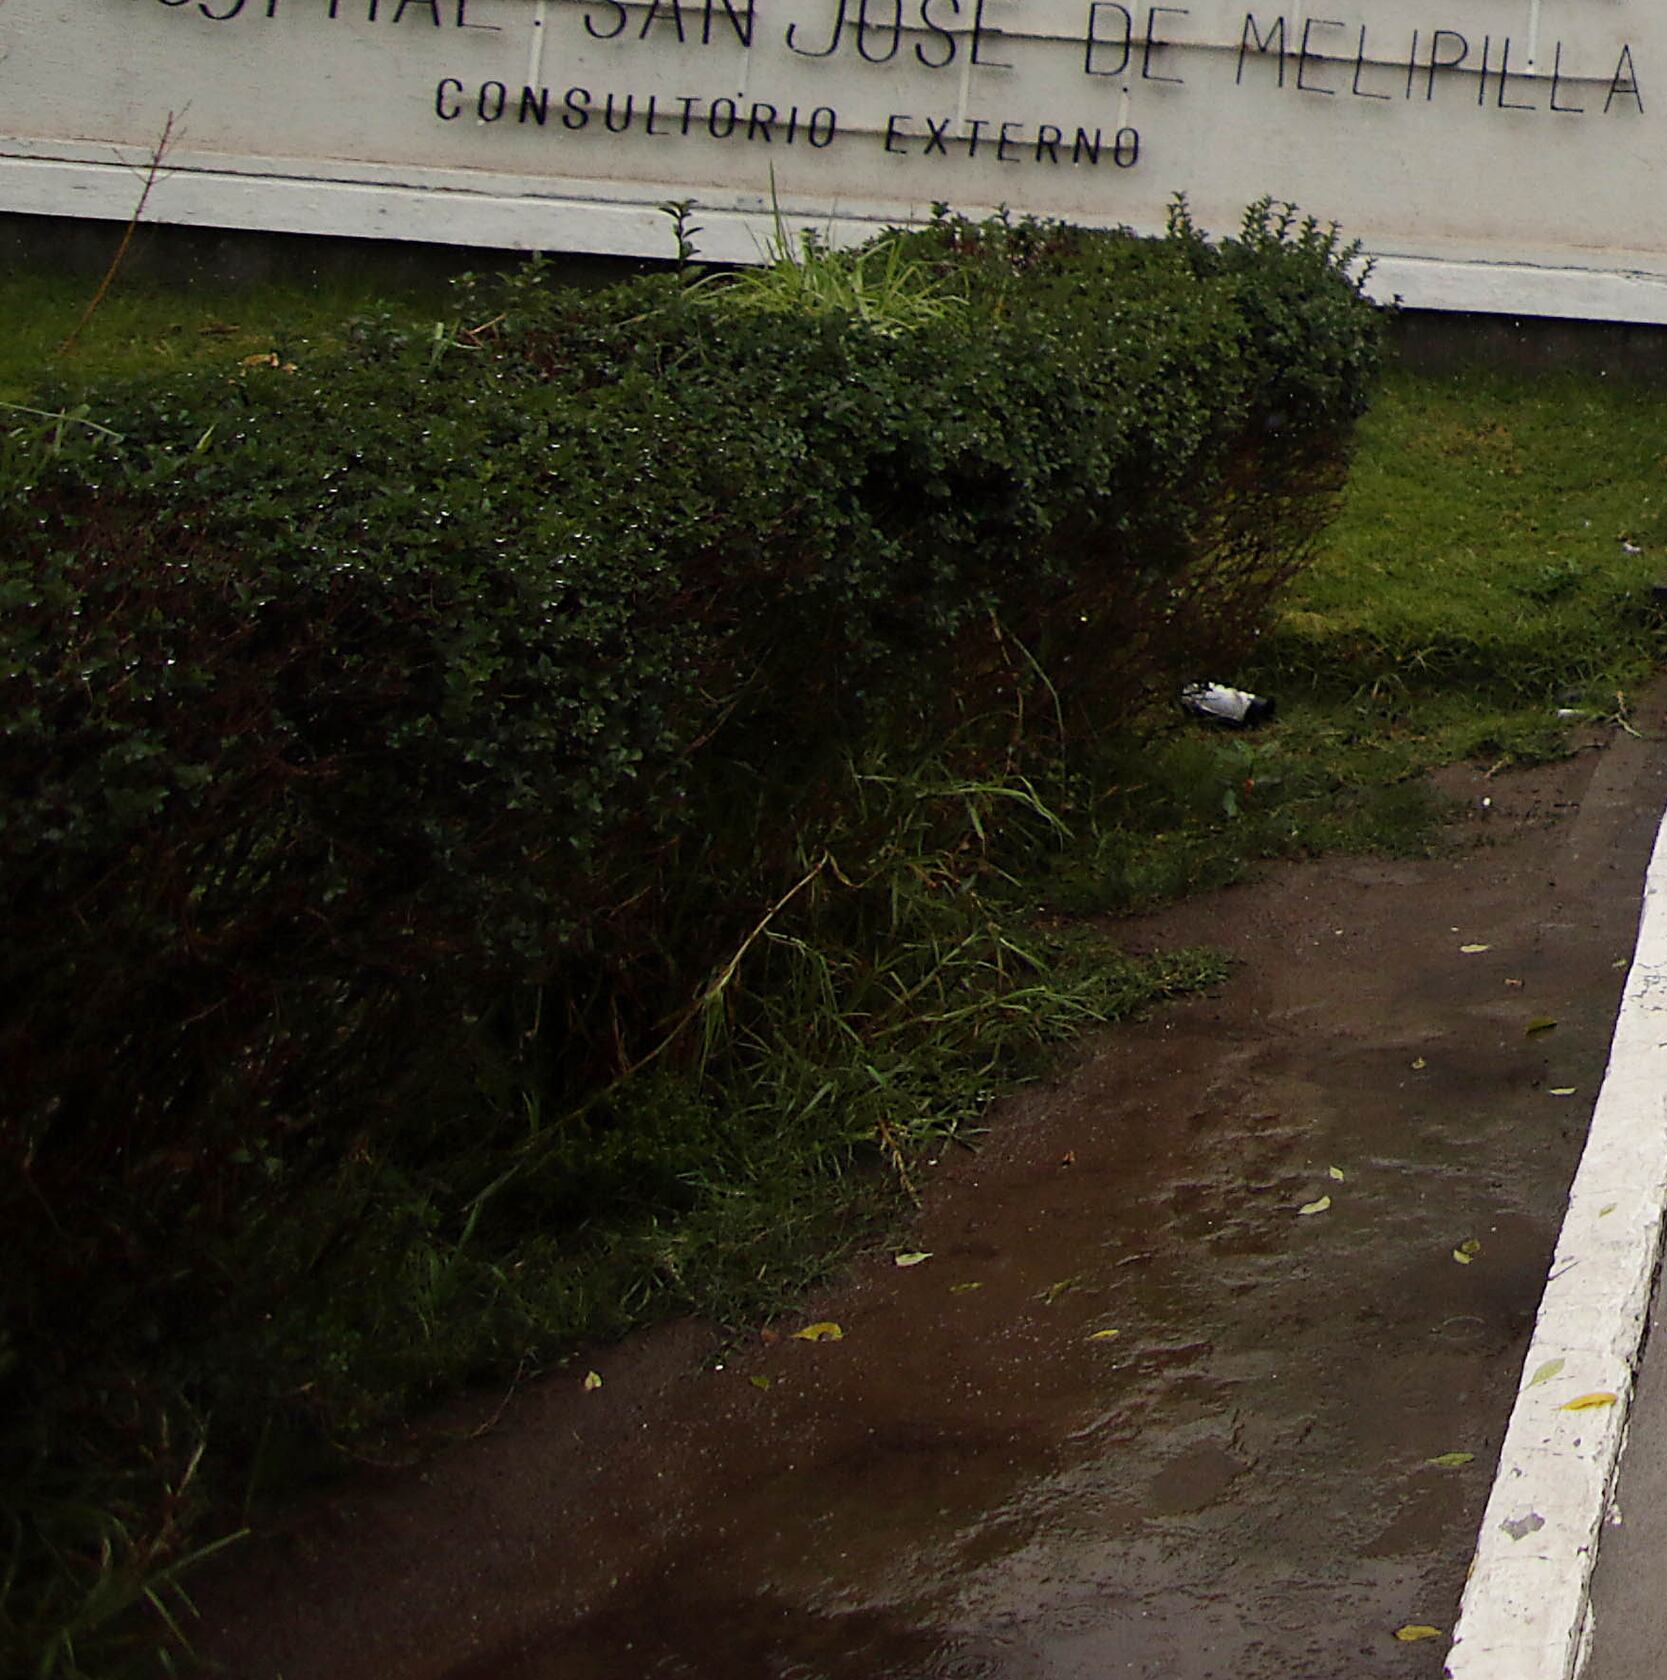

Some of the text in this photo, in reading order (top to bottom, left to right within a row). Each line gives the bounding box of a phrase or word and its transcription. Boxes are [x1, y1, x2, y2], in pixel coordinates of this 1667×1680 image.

[1083, 1, 1190, 85] DE
[1236, 12, 1644, 115] MELIPILLA
[435, 76, 1140, 170] CONSULTORIO EXTERNO
